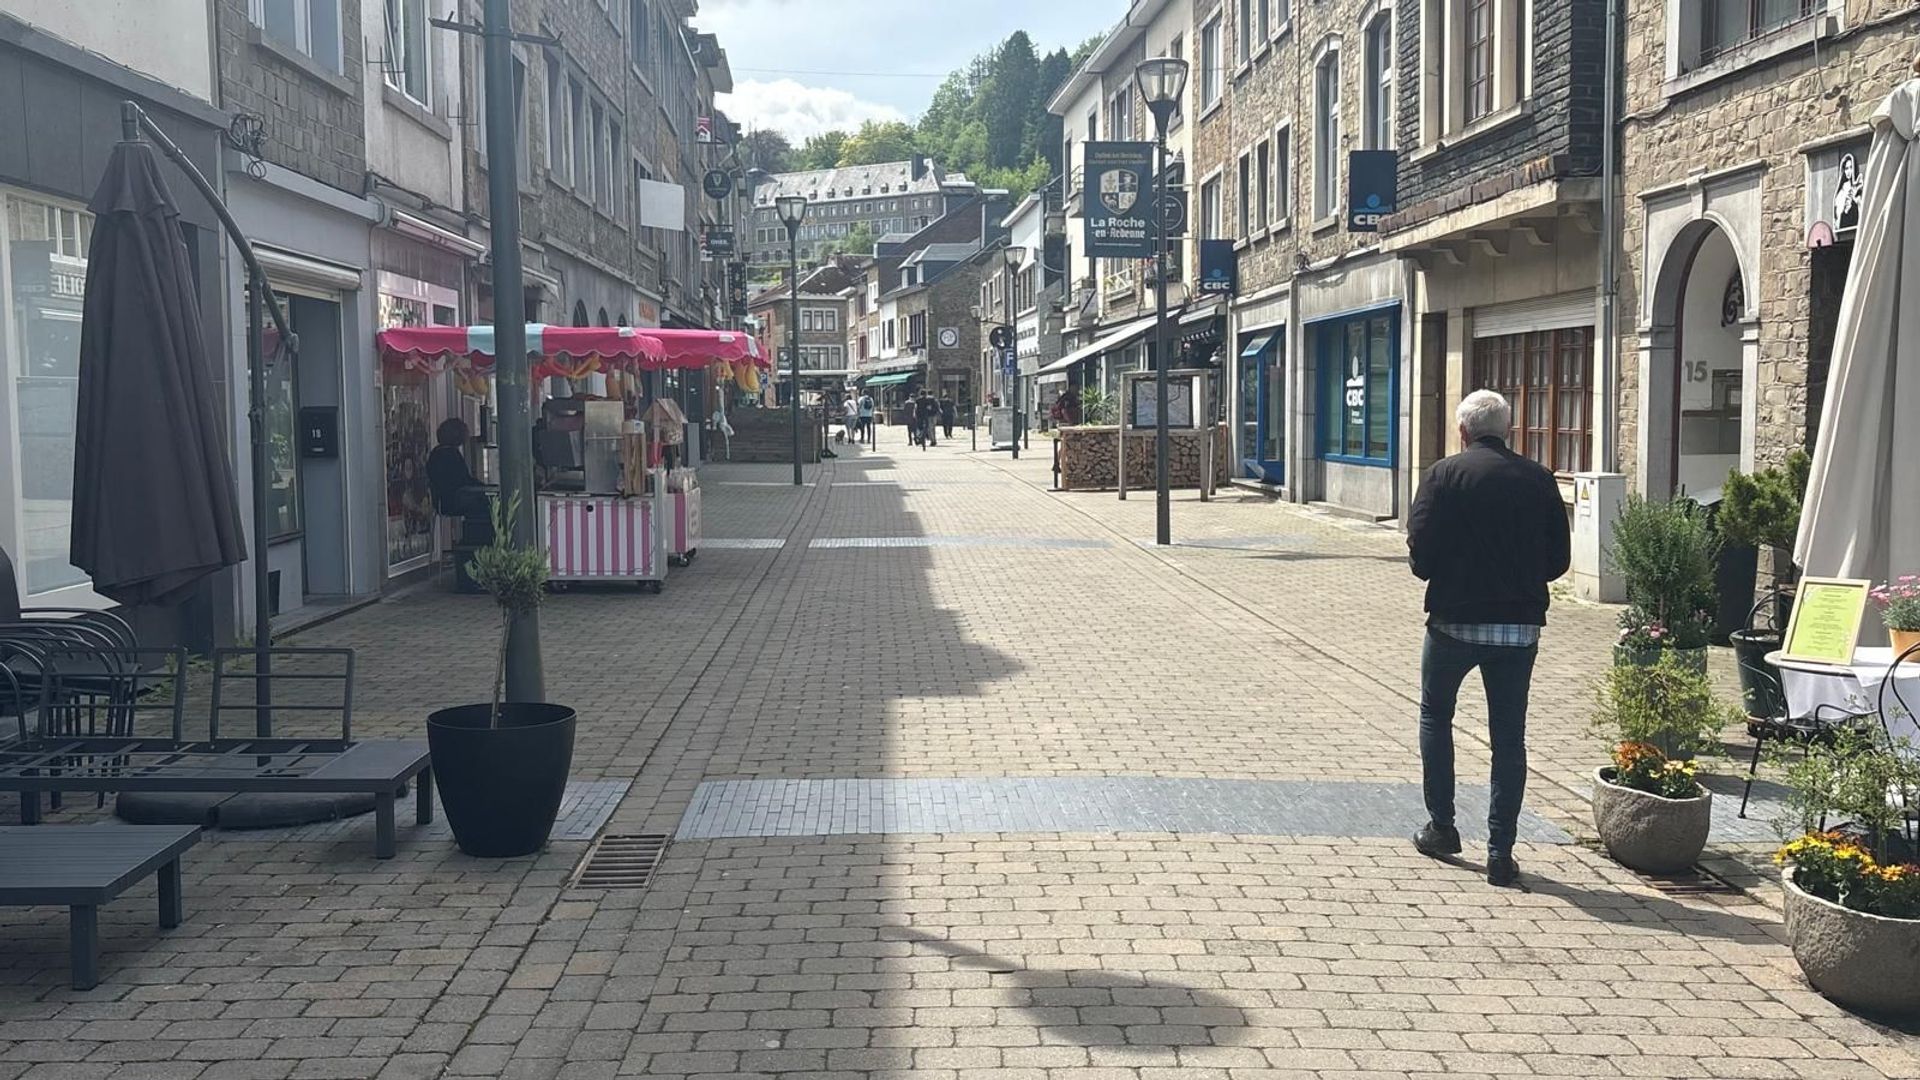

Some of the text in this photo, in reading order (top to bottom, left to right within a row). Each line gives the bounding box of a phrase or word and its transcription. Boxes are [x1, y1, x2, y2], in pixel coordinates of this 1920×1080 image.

[1090, 217, 1145, 228] La Roche
[1353, 214, 1391, 225] CB
[1203, 281, 1231, 290] CBC
[1685, 360, 1708, 383] 15
[1346, 388, 1364, 407] CBC
